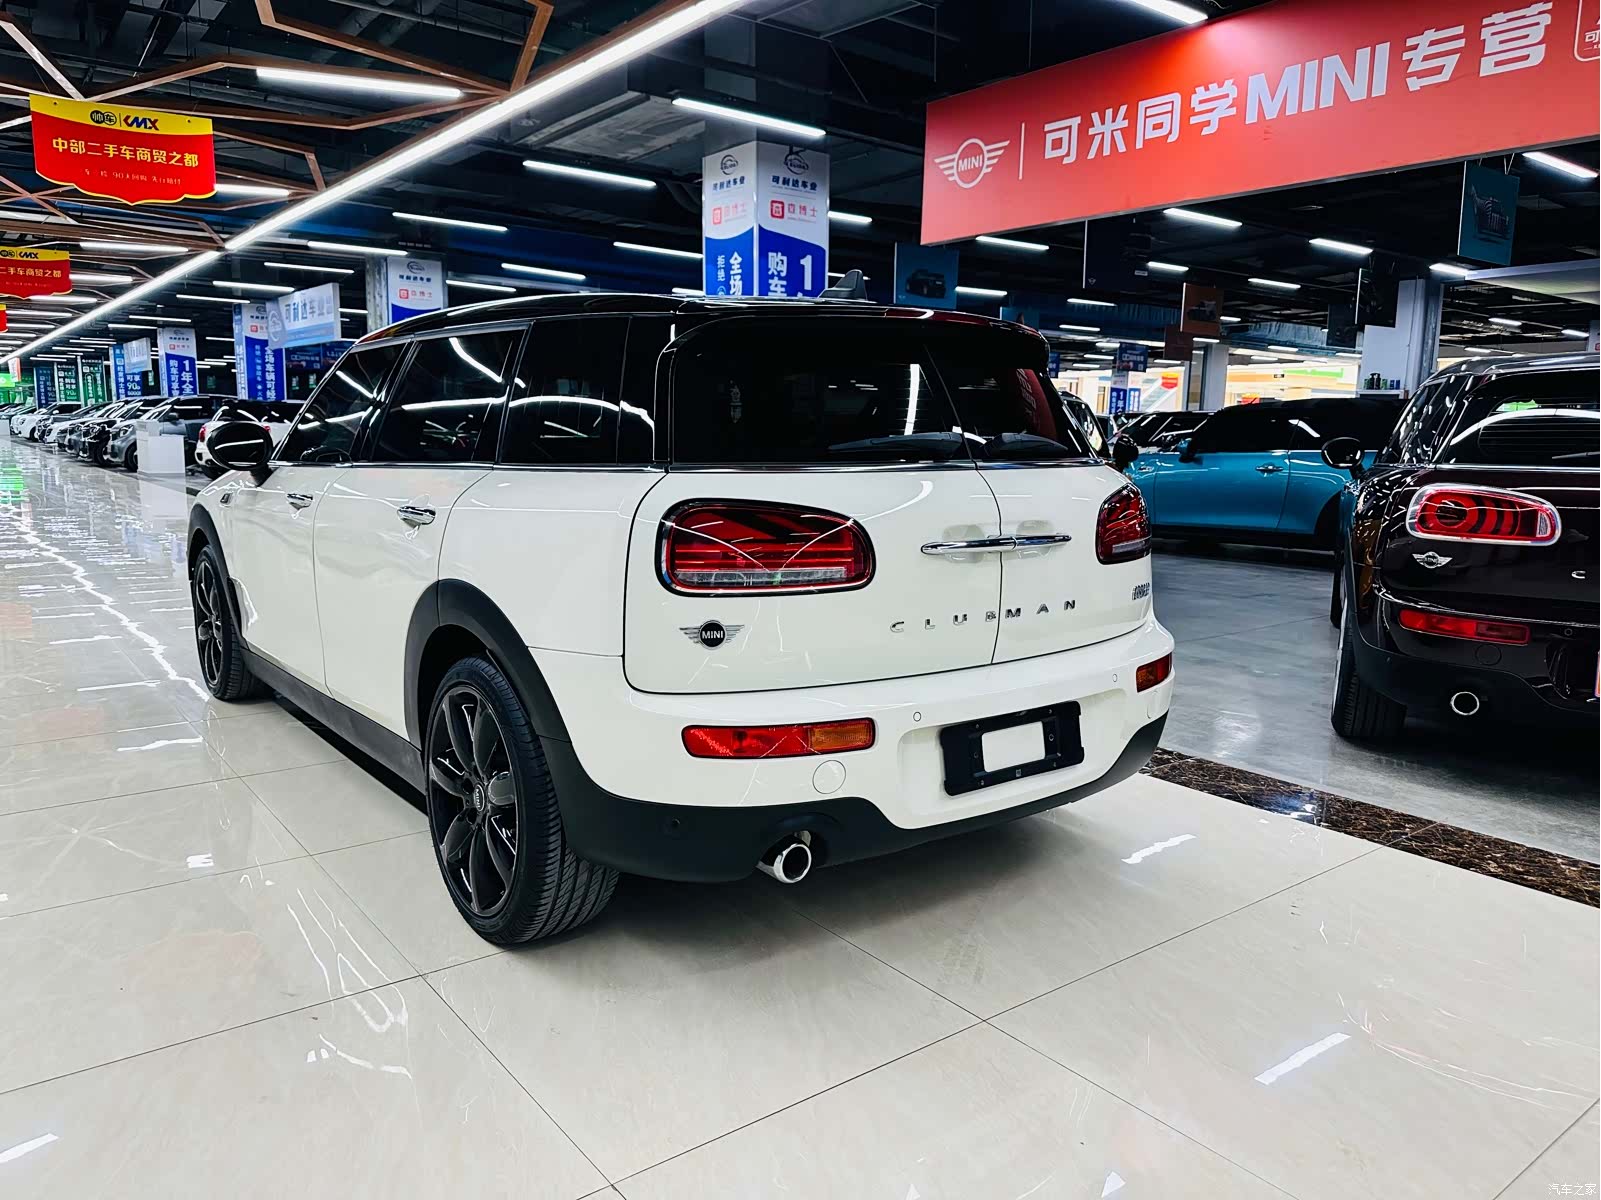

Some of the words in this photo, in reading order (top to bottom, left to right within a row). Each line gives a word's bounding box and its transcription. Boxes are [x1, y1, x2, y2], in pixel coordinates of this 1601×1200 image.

[1043, 2, 1553, 165] 可米同学MINI专营
[52, 137, 199, 168] 中部二手车商贸之都
[958, 154, 983, 172] MINI
[729, 251, 743, 296] 全场
[768, 251, 788, 297] 购车
[701, 630, 724, 640] MINI
